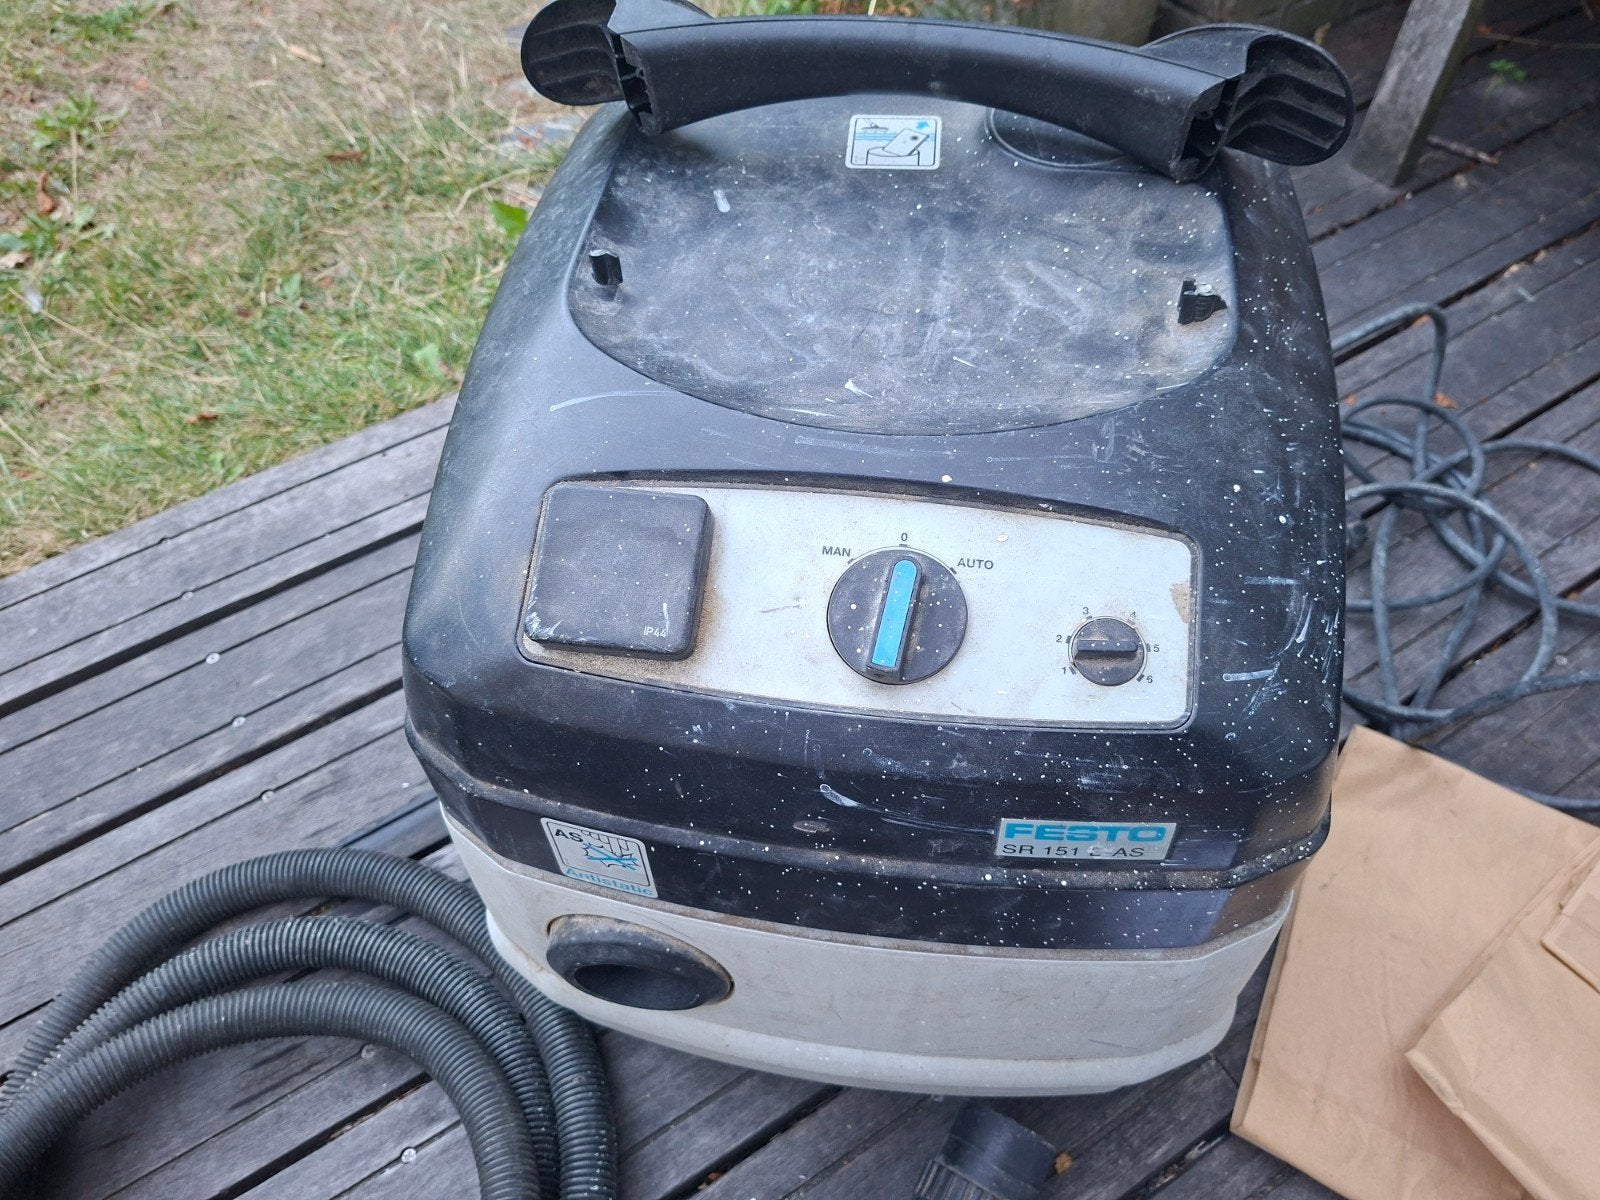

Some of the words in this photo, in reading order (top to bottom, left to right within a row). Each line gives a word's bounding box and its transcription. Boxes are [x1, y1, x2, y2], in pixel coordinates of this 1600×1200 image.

[900, 532, 908, 541] 0
[822, 546, 851, 558] MAN
[957, 557, 994, 570] AUTO
[1082, 606, 1090, 615] 3
[1129, 611, 1136, 619] 4
[643, 626, 667, 638] IP44
[1055, 634, 1063, 643] 2
[1153, 644, 1160, 652] 5
[1062, 667, 1067, 675] 1
[1146, 675, 1153, 684] 6
[555, 828, 584, 843] AS
[1004, 822, 1167, 843] FESTO
[1002, 843, 1034, 856] SR
[1044, 846, 1079, 857] 151
[1111, 847, 1145, 858] AS
[565, 867, 653, 896] Antistatic
